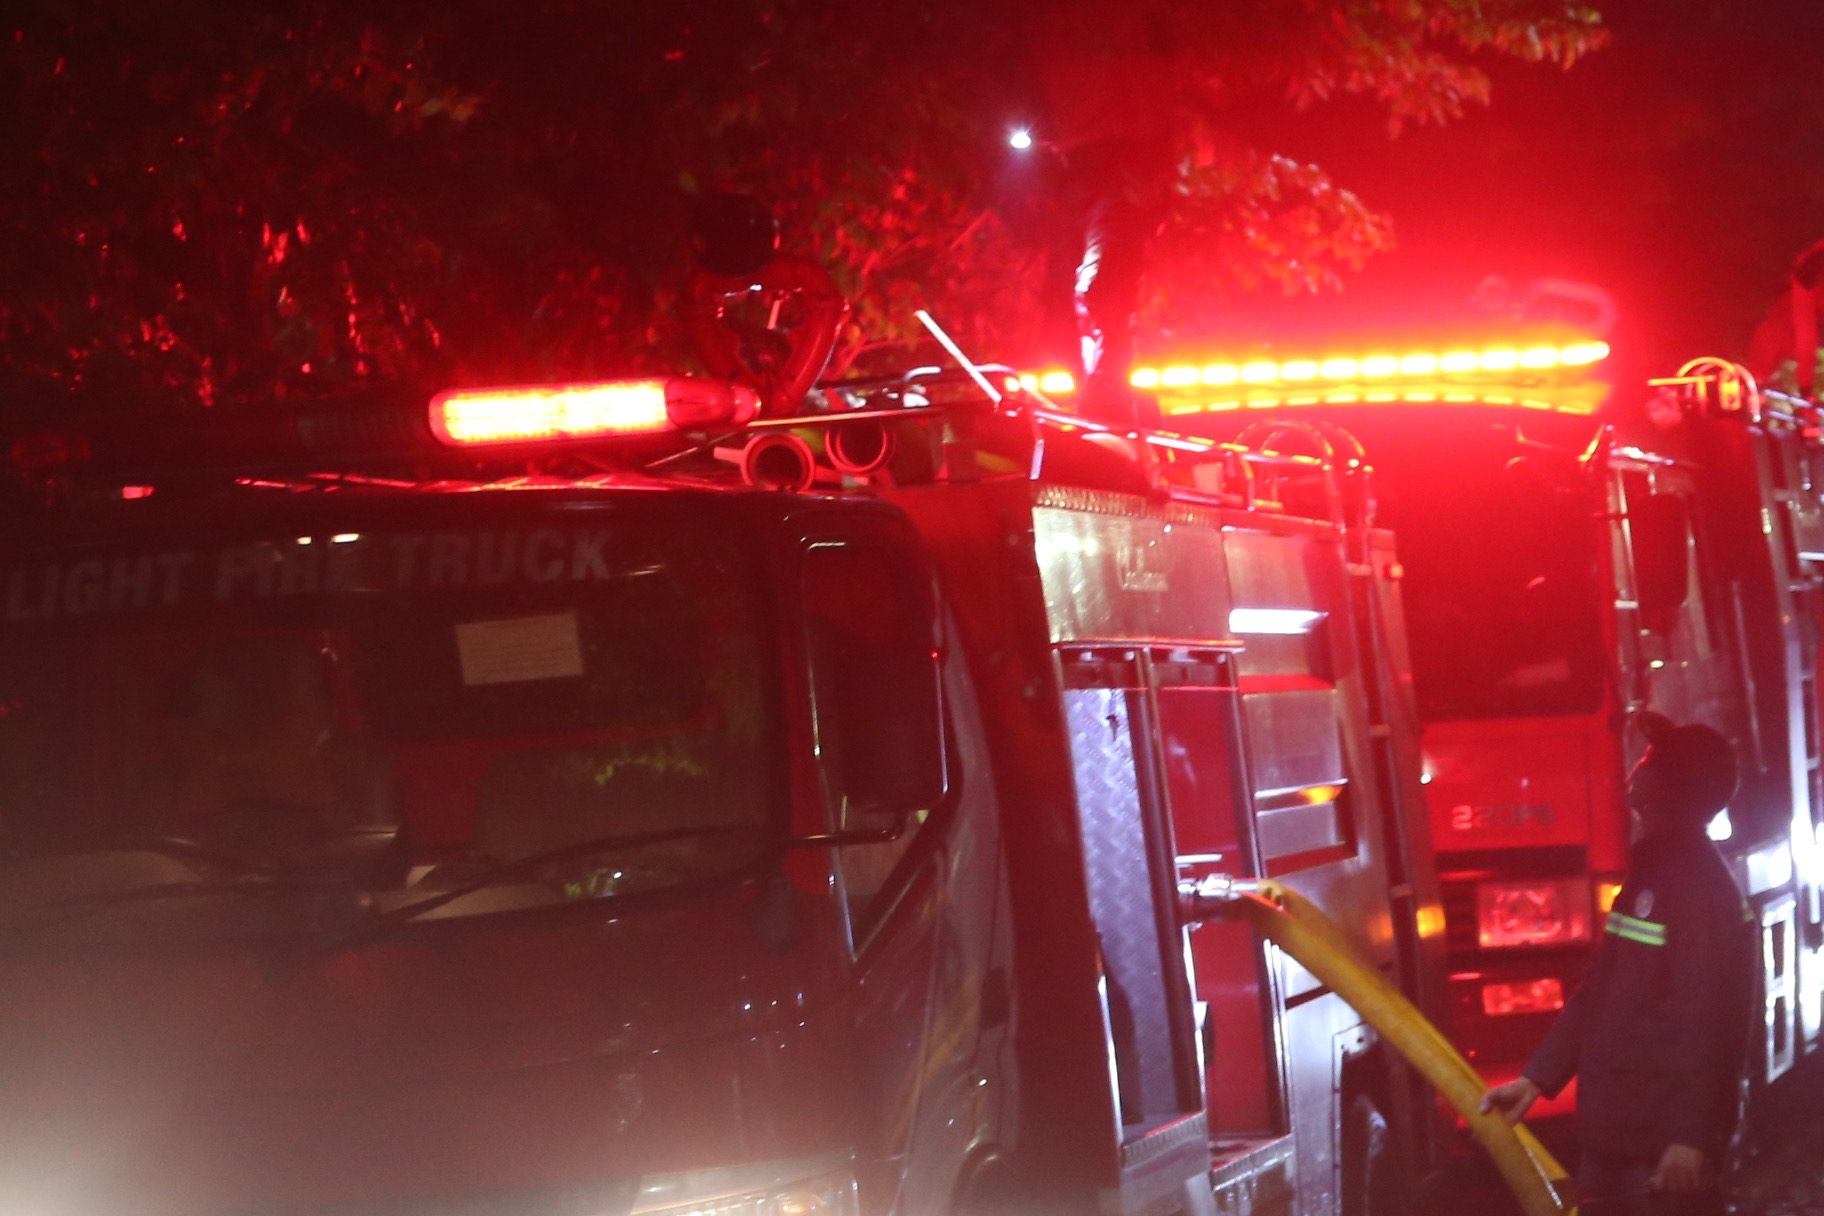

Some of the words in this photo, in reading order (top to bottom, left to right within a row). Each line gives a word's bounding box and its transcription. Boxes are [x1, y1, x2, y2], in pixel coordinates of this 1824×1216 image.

[4, 552, 196, 622] LIGHT
[213, 543, 364, 601] FIRE
[390, 529, 615, 585] TRUCK
